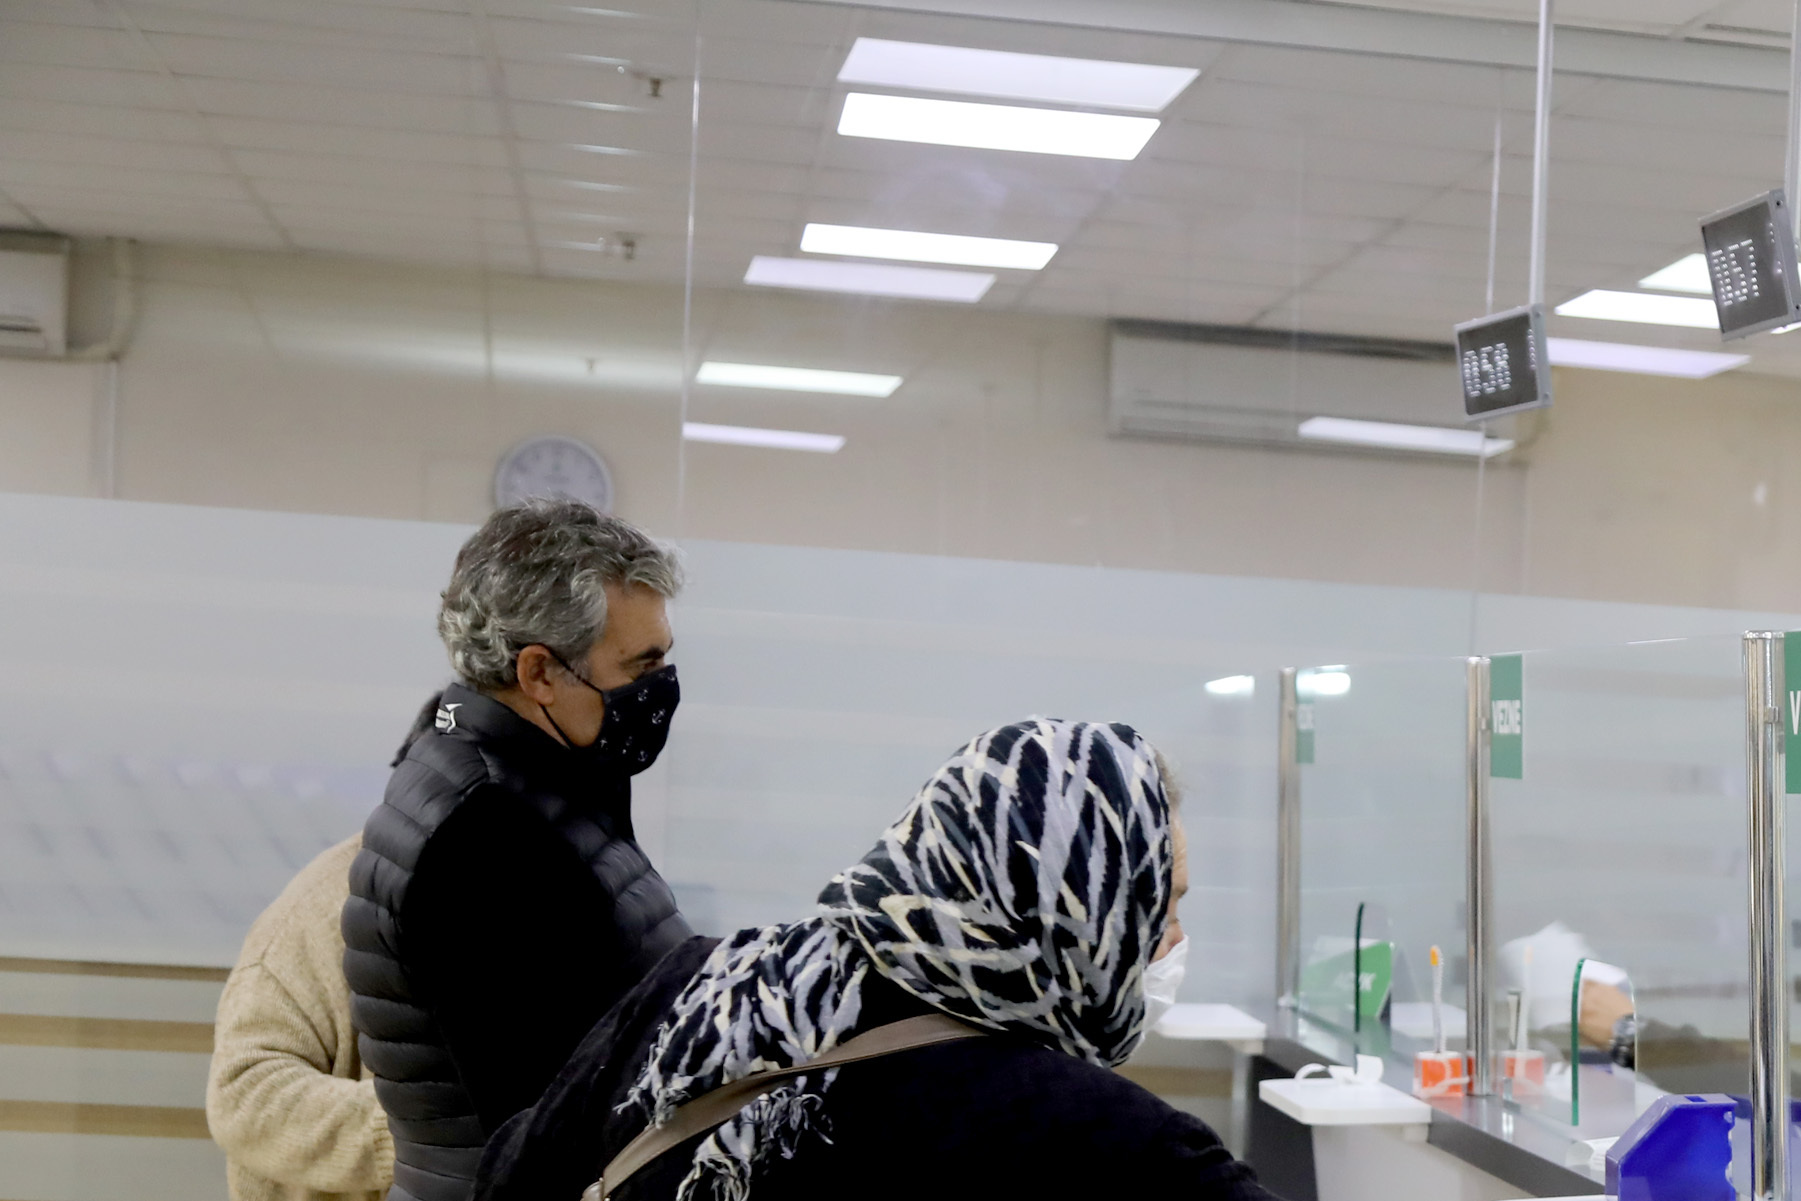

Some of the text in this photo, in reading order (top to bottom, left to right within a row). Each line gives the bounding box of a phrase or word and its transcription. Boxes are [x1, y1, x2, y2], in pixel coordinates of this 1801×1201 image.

[1711, 238, 1761, 306] 057
[1463, 342, 1512, 397] 058
[1491, 699, 1521, 734] VEZNE
